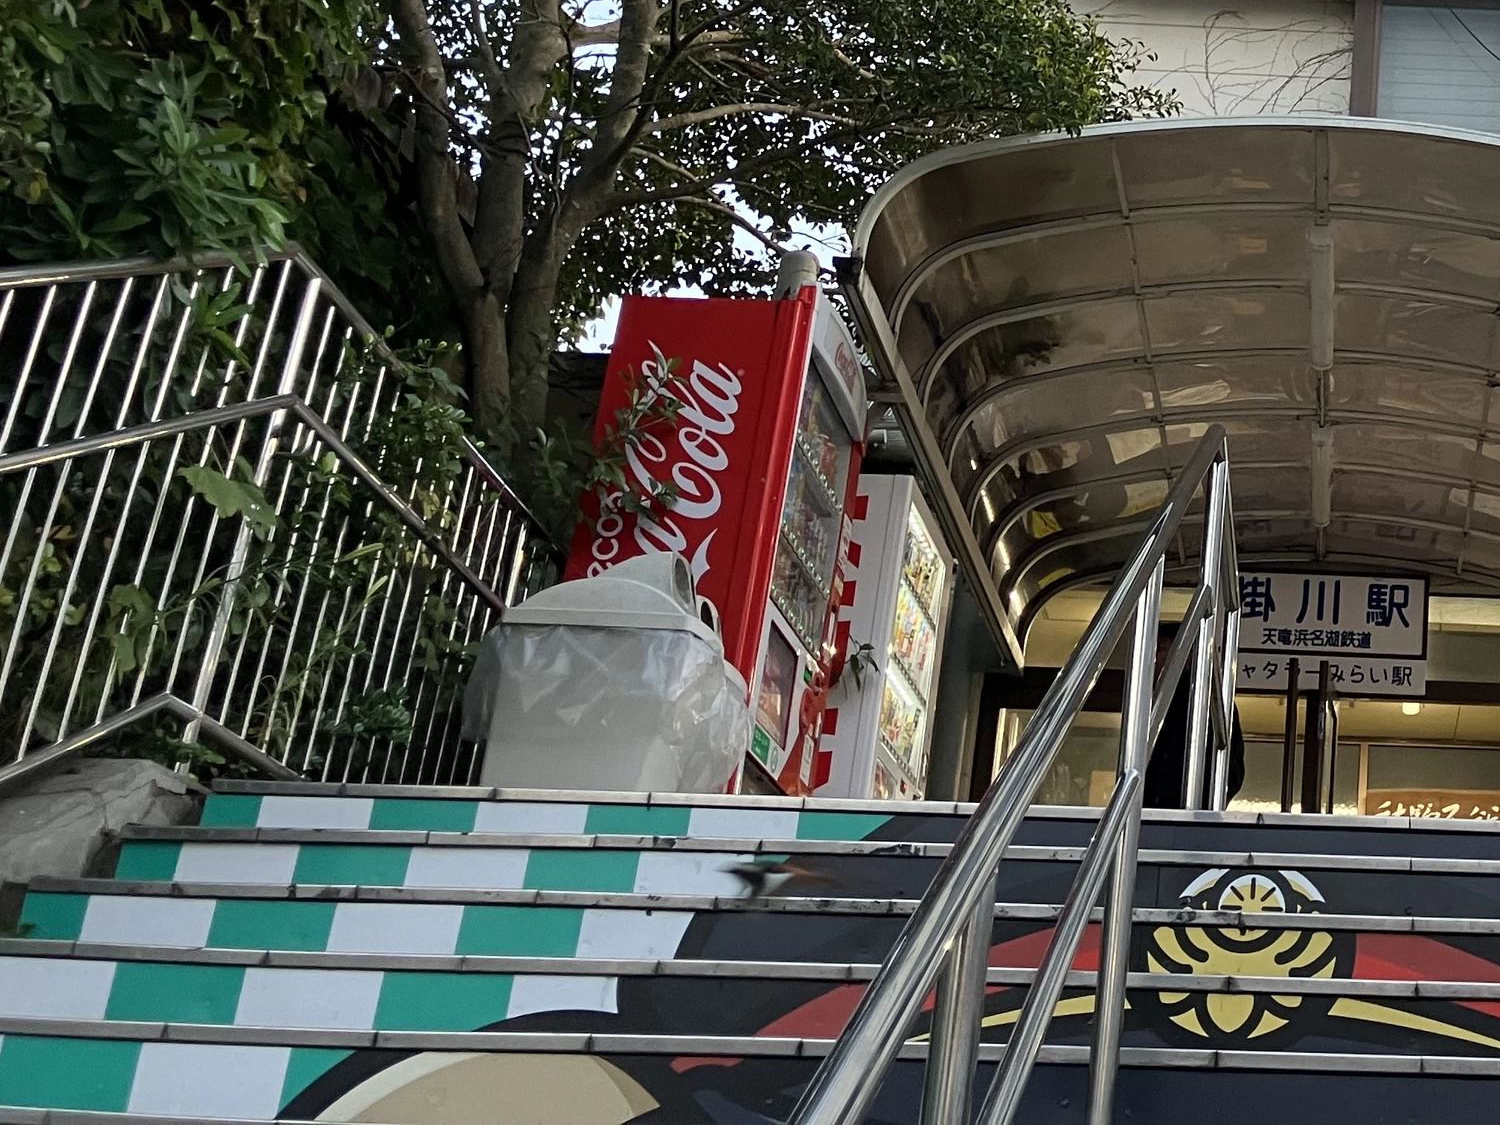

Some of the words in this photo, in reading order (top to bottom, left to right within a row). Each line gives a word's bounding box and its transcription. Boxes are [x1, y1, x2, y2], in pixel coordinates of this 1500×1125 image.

[1239, 575, 1410, 628] 掛川駅
[1261, 627, 1372, 649] 天竜浜名湖鉄道
